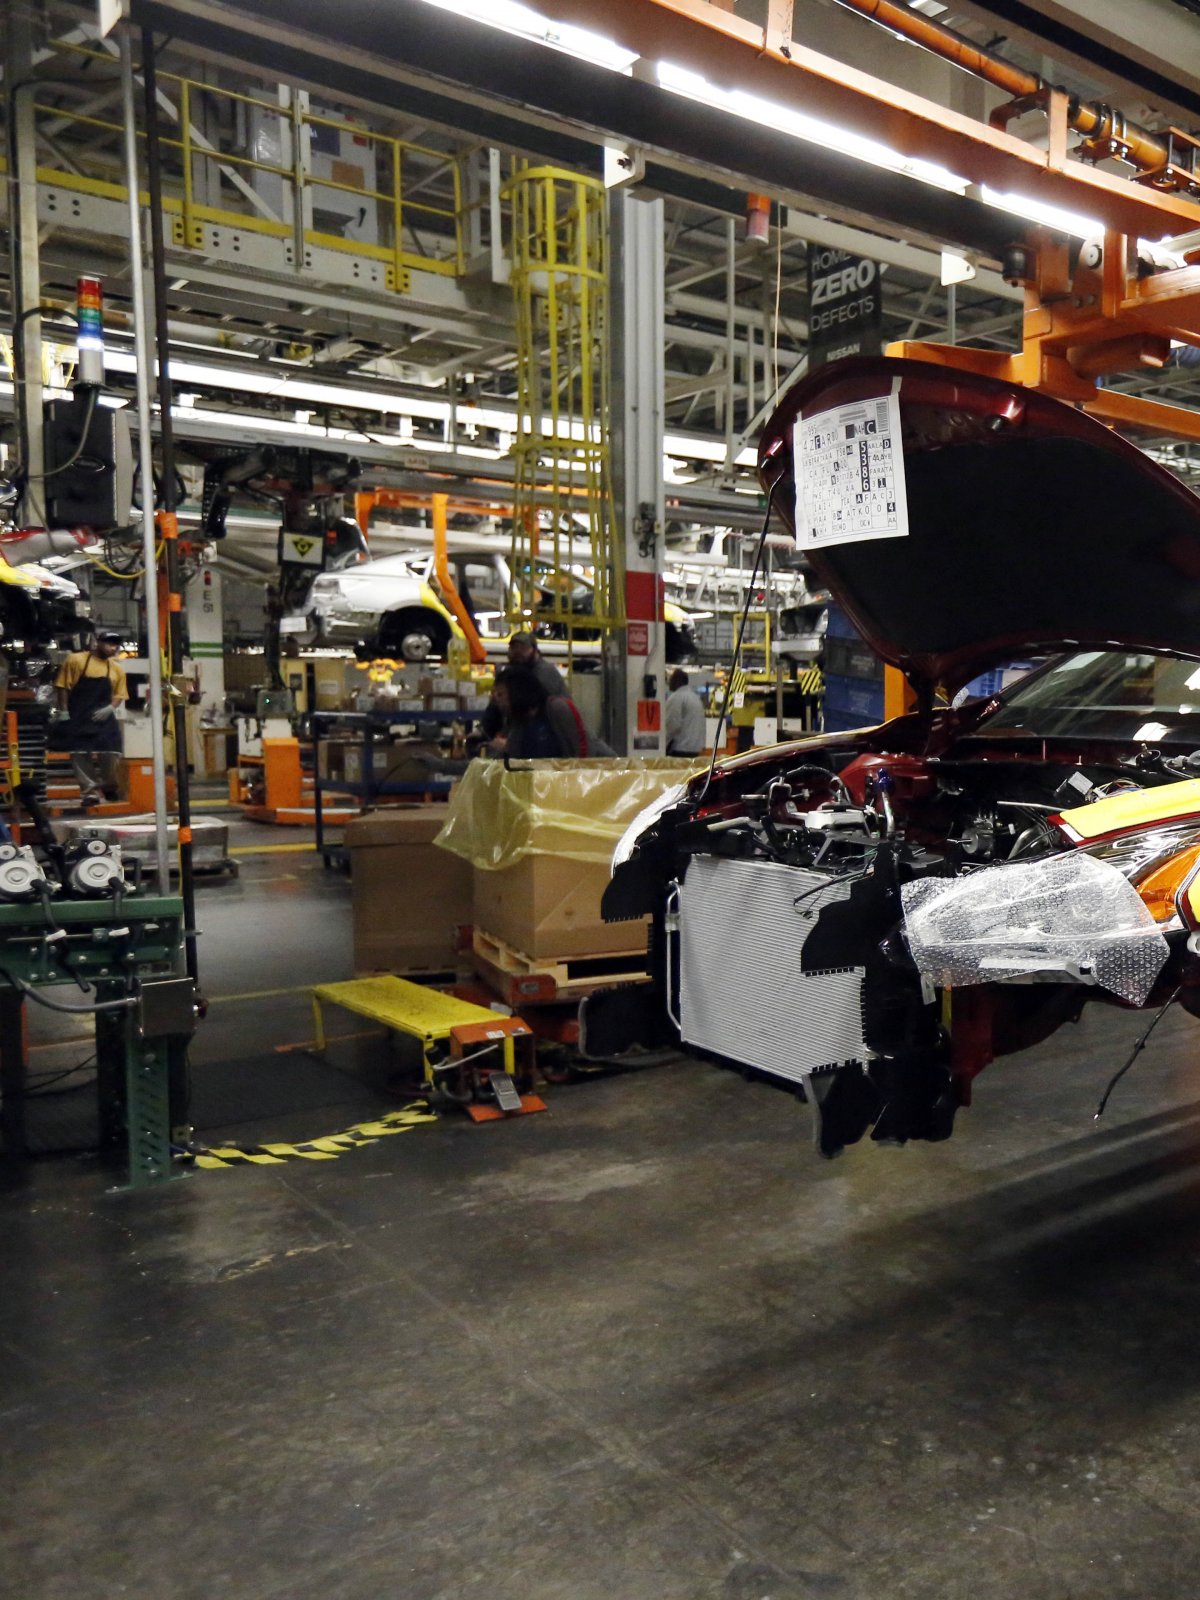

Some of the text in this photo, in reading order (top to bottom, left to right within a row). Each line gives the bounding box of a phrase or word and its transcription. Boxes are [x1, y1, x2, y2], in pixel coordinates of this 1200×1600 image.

[811, 259, 876, 307] ZERO
[810, 295, 875, 332] DEFECTS
[826, 343, 861, 361] NISSAN
[860, 441, 870, 491] 5386
